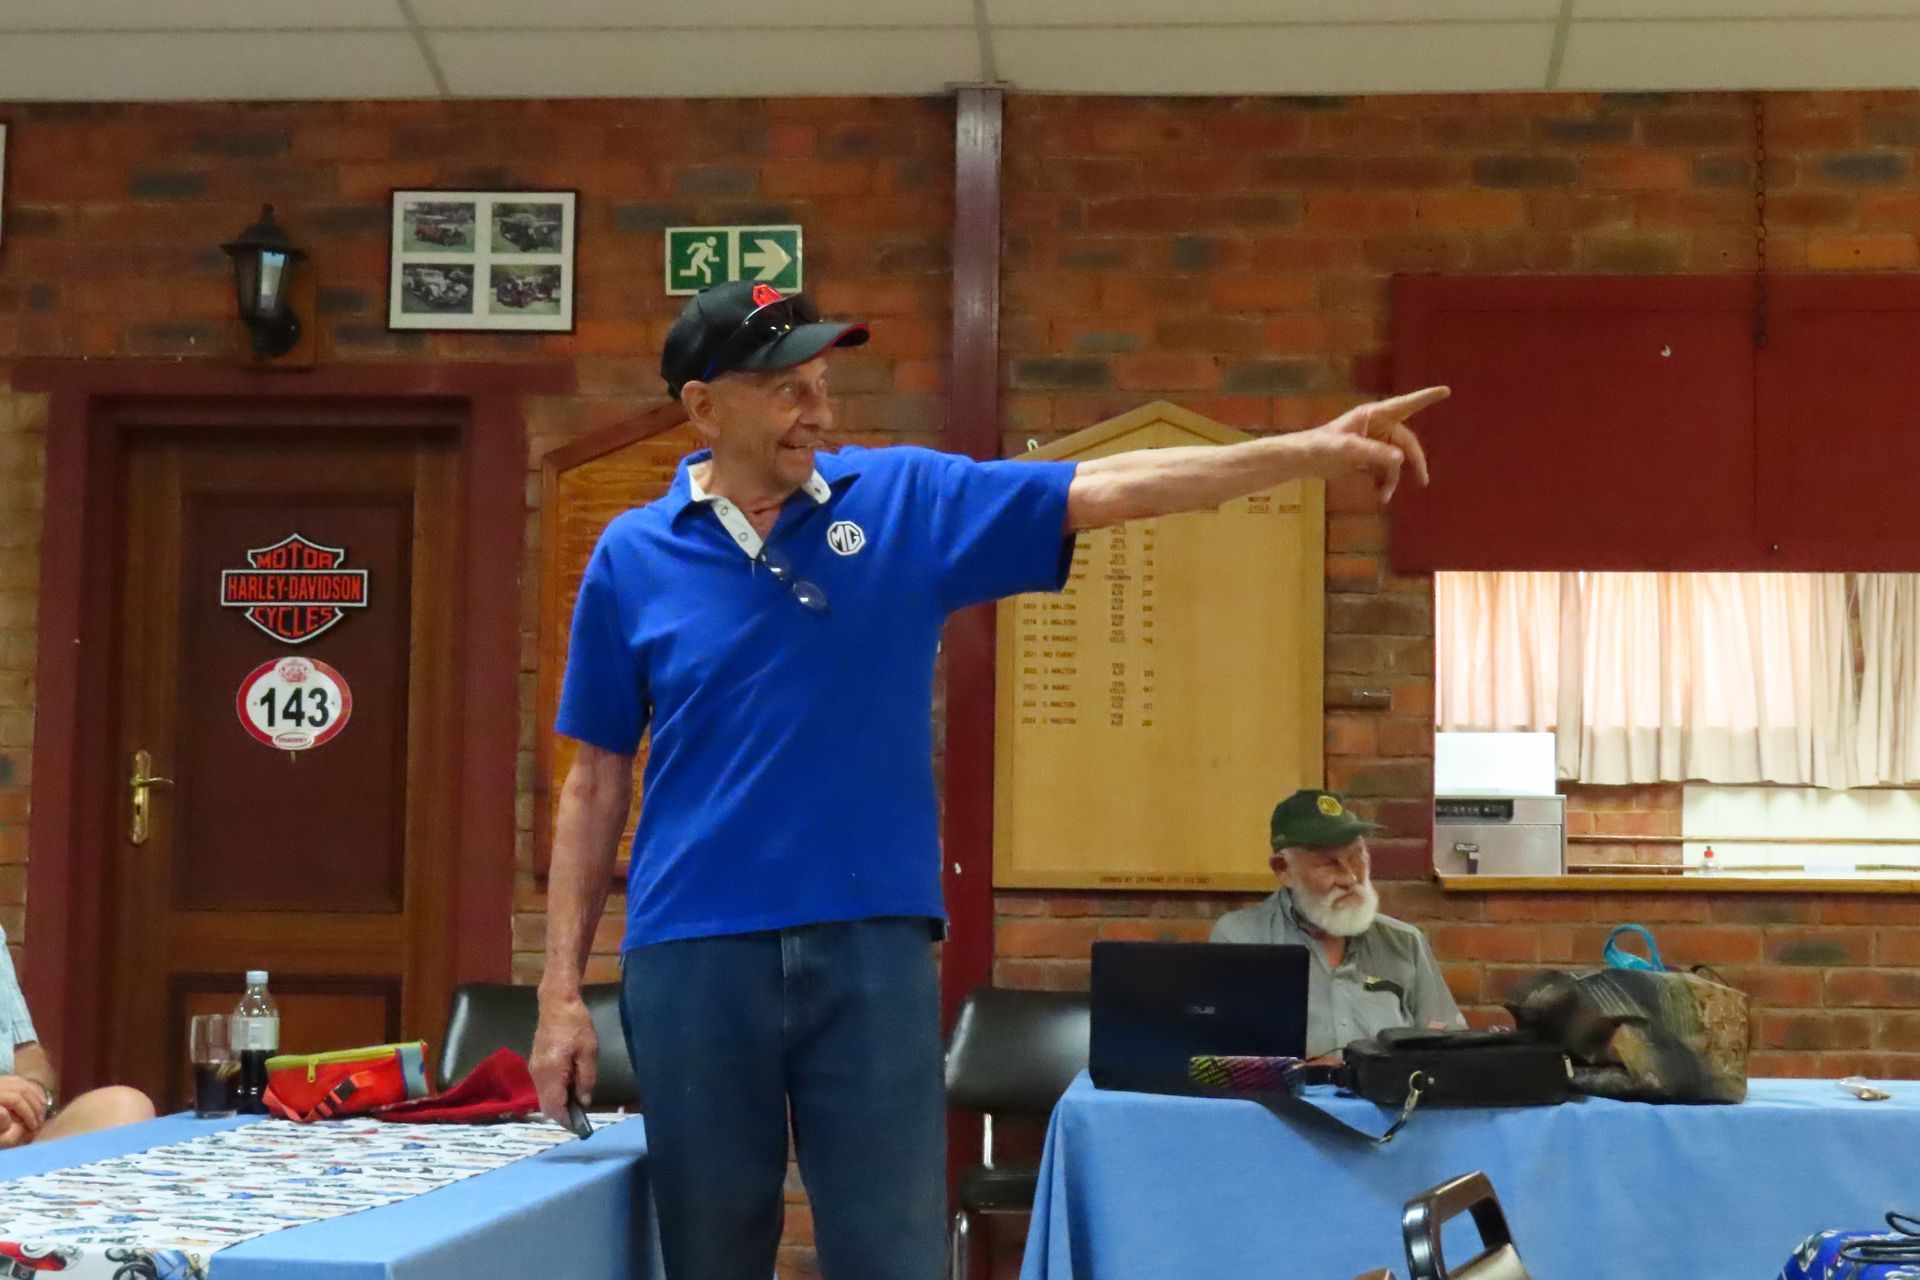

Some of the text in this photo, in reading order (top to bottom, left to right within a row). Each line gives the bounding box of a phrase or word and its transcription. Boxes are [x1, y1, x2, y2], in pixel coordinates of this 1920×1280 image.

[831, 524, 861, 552] MG
[256, 541, 334, 569] MOTOR
[227, 575, 361, 600] HARLEY-DAVIDSON
[254, 606, 334, 637] CYCLES
[259, 687, 330, 728] 143
